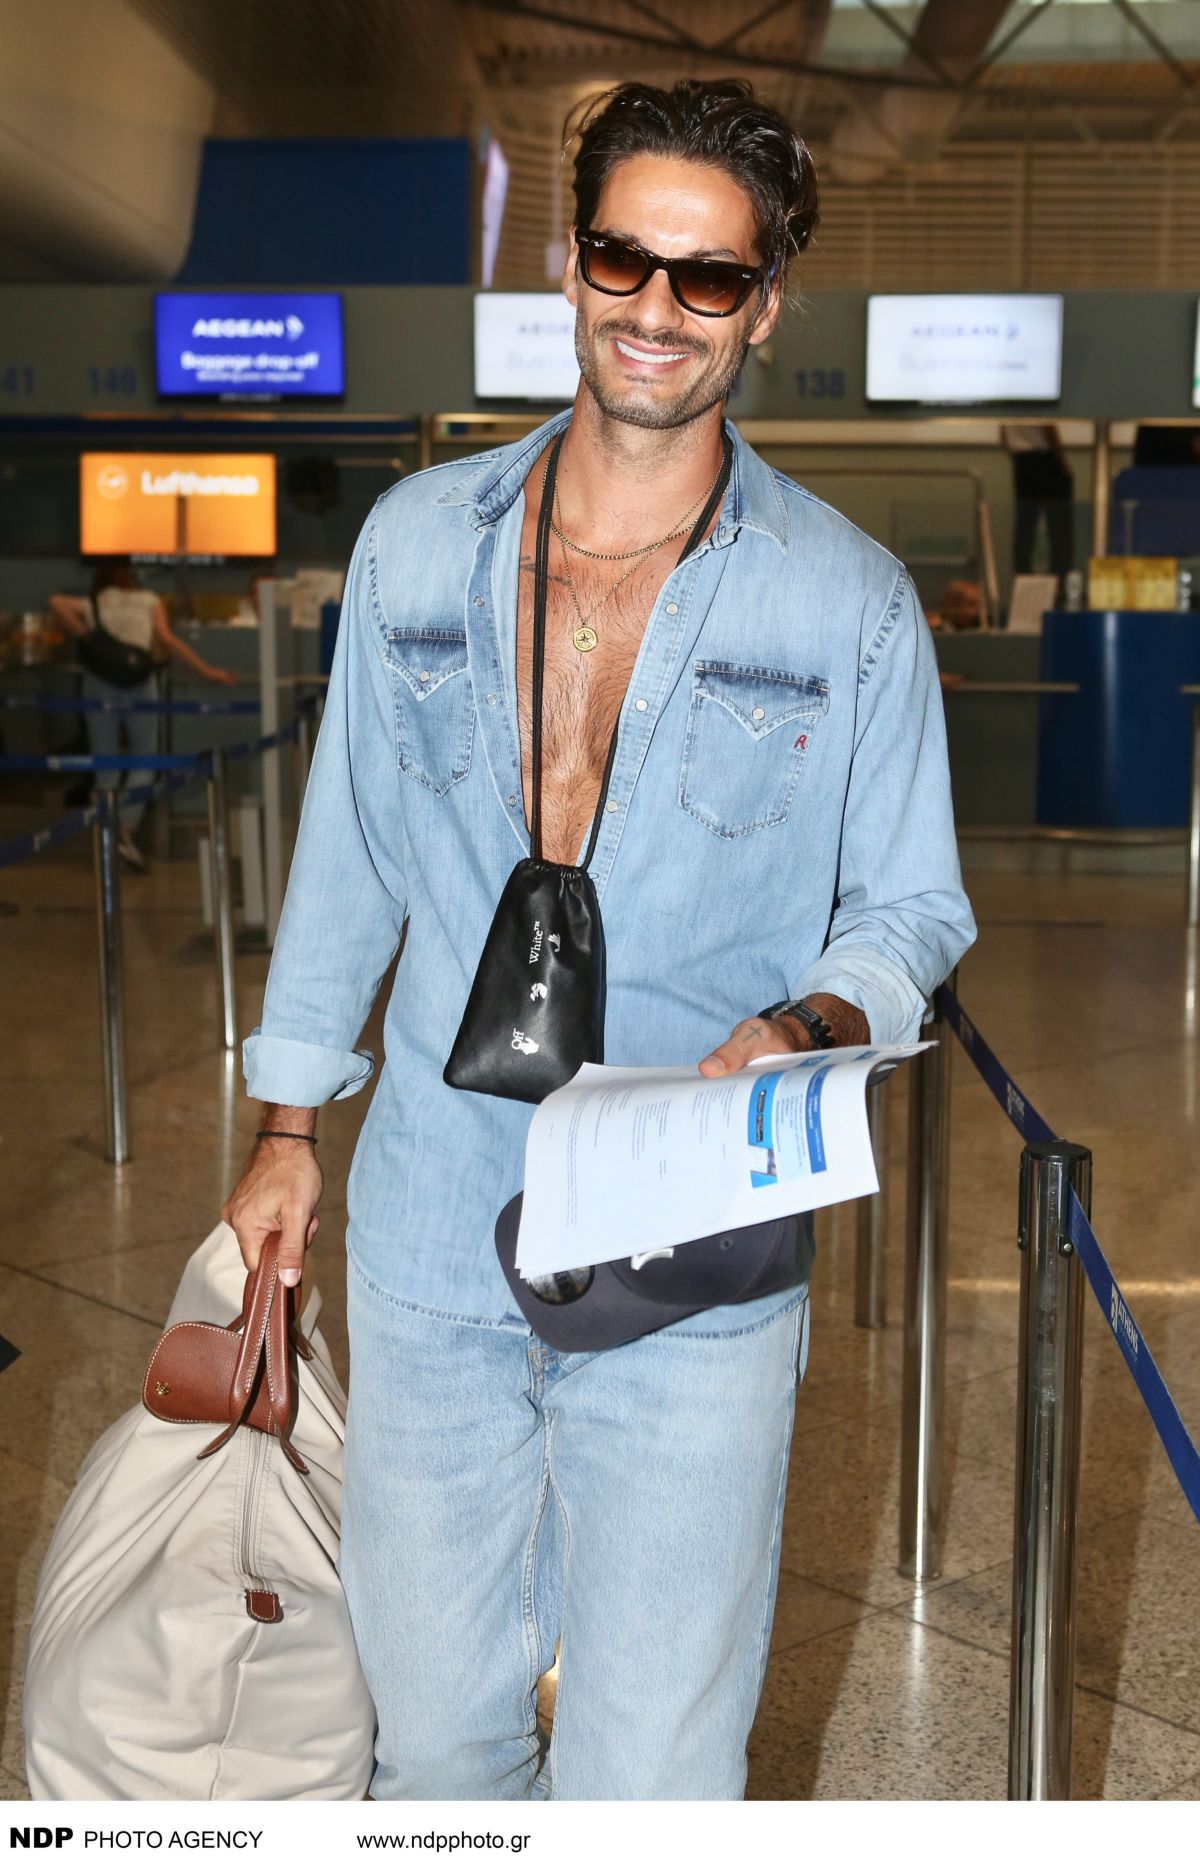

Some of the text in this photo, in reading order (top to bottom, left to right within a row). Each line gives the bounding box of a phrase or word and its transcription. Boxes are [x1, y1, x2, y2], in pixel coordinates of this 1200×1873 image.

[192, 318, 285, 338] AEGEAN
[0, 366, 35, 397] 41
[795, 367, 846, 398] 138
[141, 470, 259, 496] Lufthansa
[1118, 1299, 1138, 1354] ATHENS
